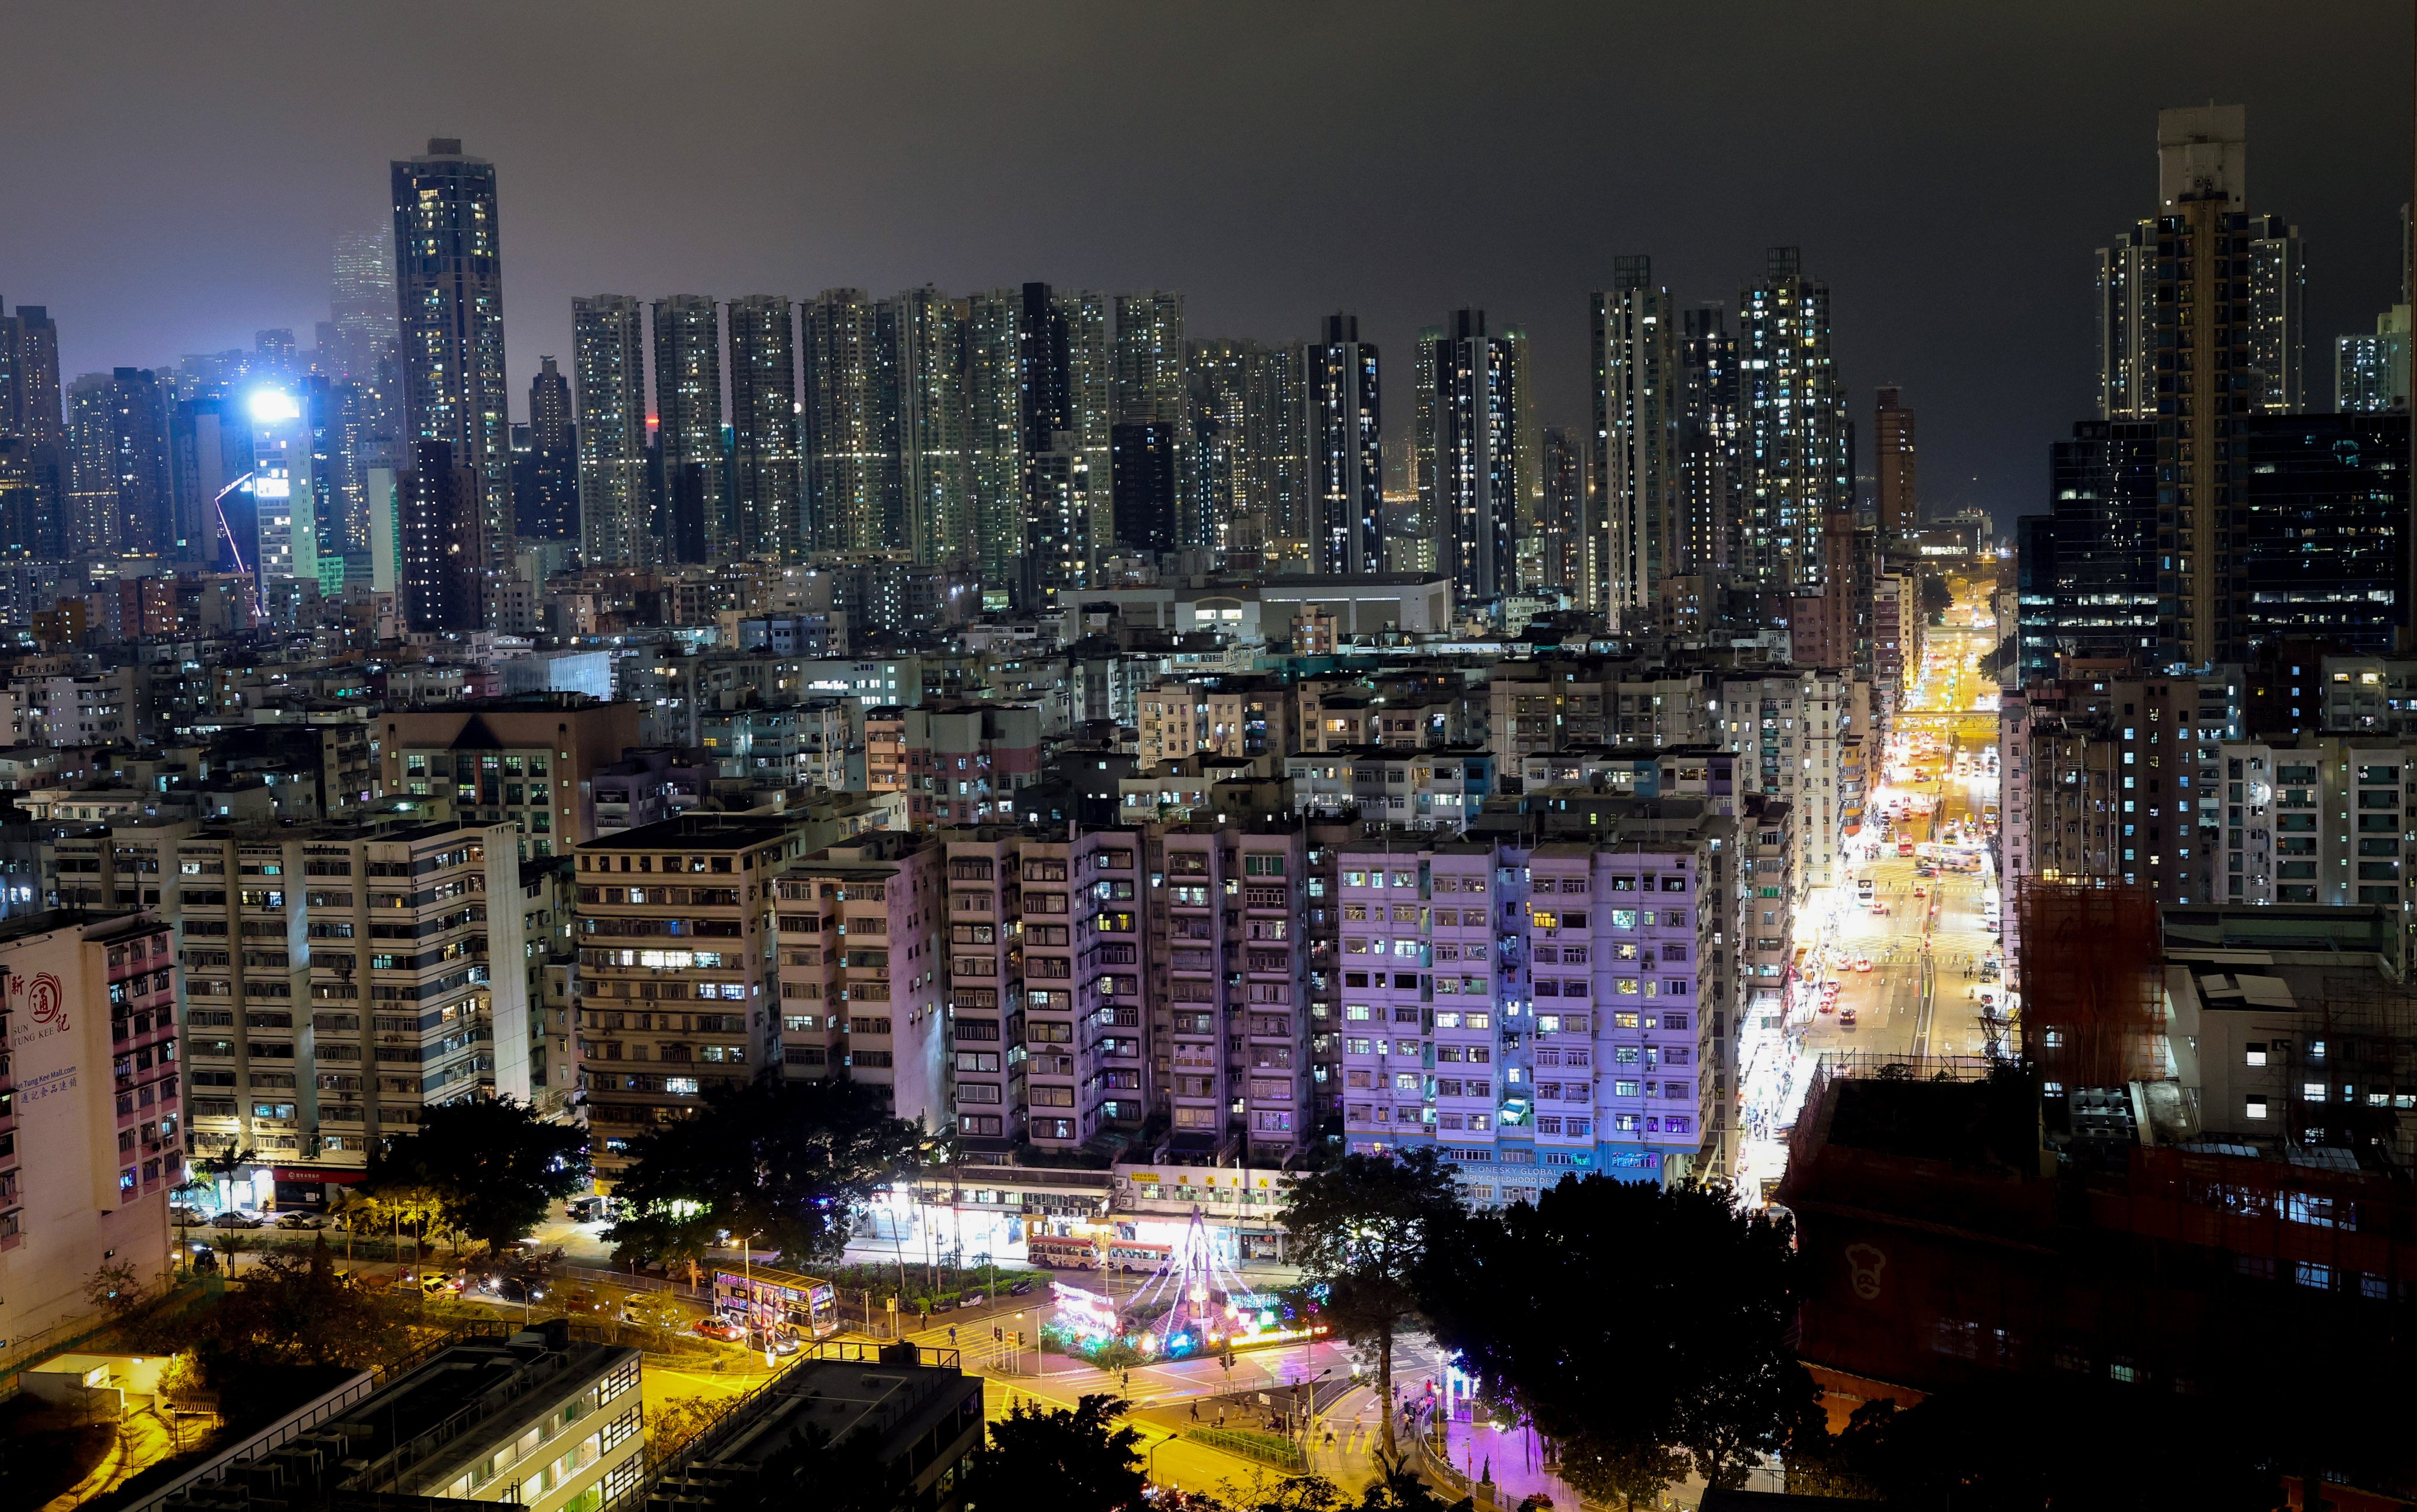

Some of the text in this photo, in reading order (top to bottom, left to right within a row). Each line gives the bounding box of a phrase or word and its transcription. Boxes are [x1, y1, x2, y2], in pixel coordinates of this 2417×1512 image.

[38, 1027, 54, 1039] KEE
[24, 1078, 38, 1087] Tung
[39, 1074, 50, 1082] Kee
[1486, 1175, 1537, 1184] CHILDHOOD
